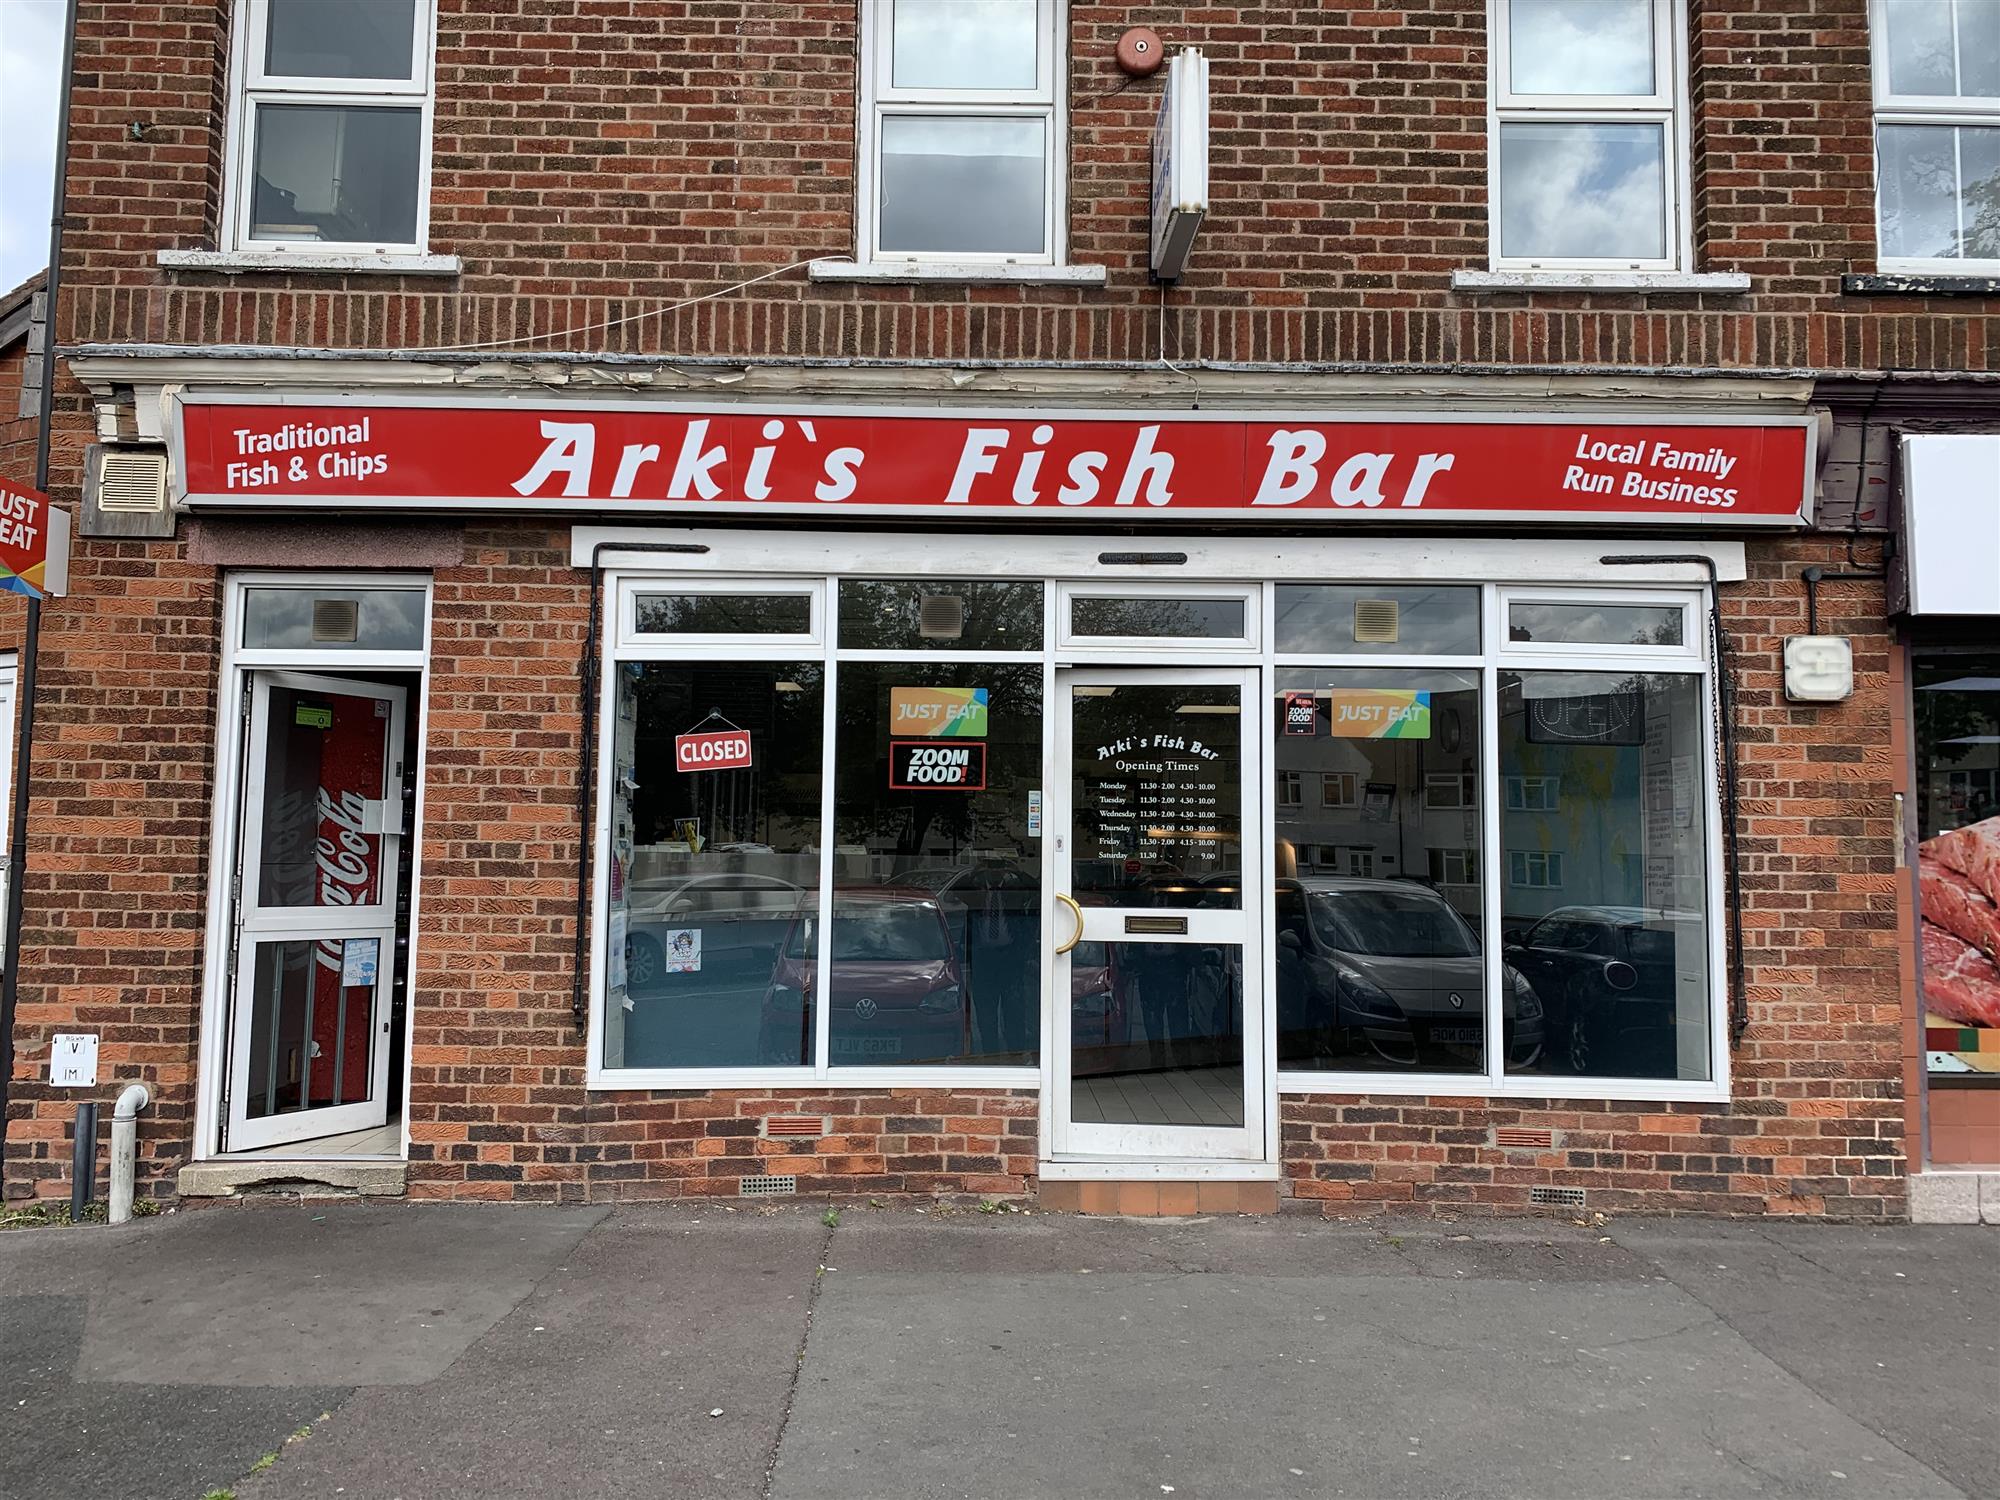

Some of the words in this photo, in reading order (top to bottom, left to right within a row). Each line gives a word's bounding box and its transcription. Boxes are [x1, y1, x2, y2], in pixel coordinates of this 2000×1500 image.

[233, 416, 370, 455] Traditional
[943, 424, 1175, 506] Fish
[1251, 429, 1456, 508] Bar
[1575, 433, 1647, 465] Local
[1649, 442, 1737, 481] Family
[227, 459, 279, 489] Fish
[287, 455, 309, 482] &
[317, 450, 388, 481] Chips
[1562, 464, 1615, 494] Run
[1621, 471, 1738, 508] Business
[0, 489, 39, 524] UST
[0, 517, 38, 551] EAT
[897, 703, 942, 721] JUST
[946, 703, 981, 720] EAT
[1338, 703, 1384, 722] JUST
[1387, 703, 1424, 722] EAT
[680, 739, 748, 763] CLOSED
[1153, 734, 1185, 750] Fish
[1189, 740, 1219, 761] Bar
[909, 748, 969, 766] ZOOM
[1115, 759, 1163, 773] Opening
[1165, 760, 1200, 771] Times
[906, 765, 968, 783] FOOD!
[1100, 782, 1126, 791] Monday
[1100, 796, 1126, 805] Tuesday
[1100, 810, 1136, 819] Wednesday
[1099, 824, 1130, 832] Thursday
[1099, 838, 1120, 846] Friday
[1098, 852, 1128, 860] Saturday
[72, 1042, 78, 1054] V
